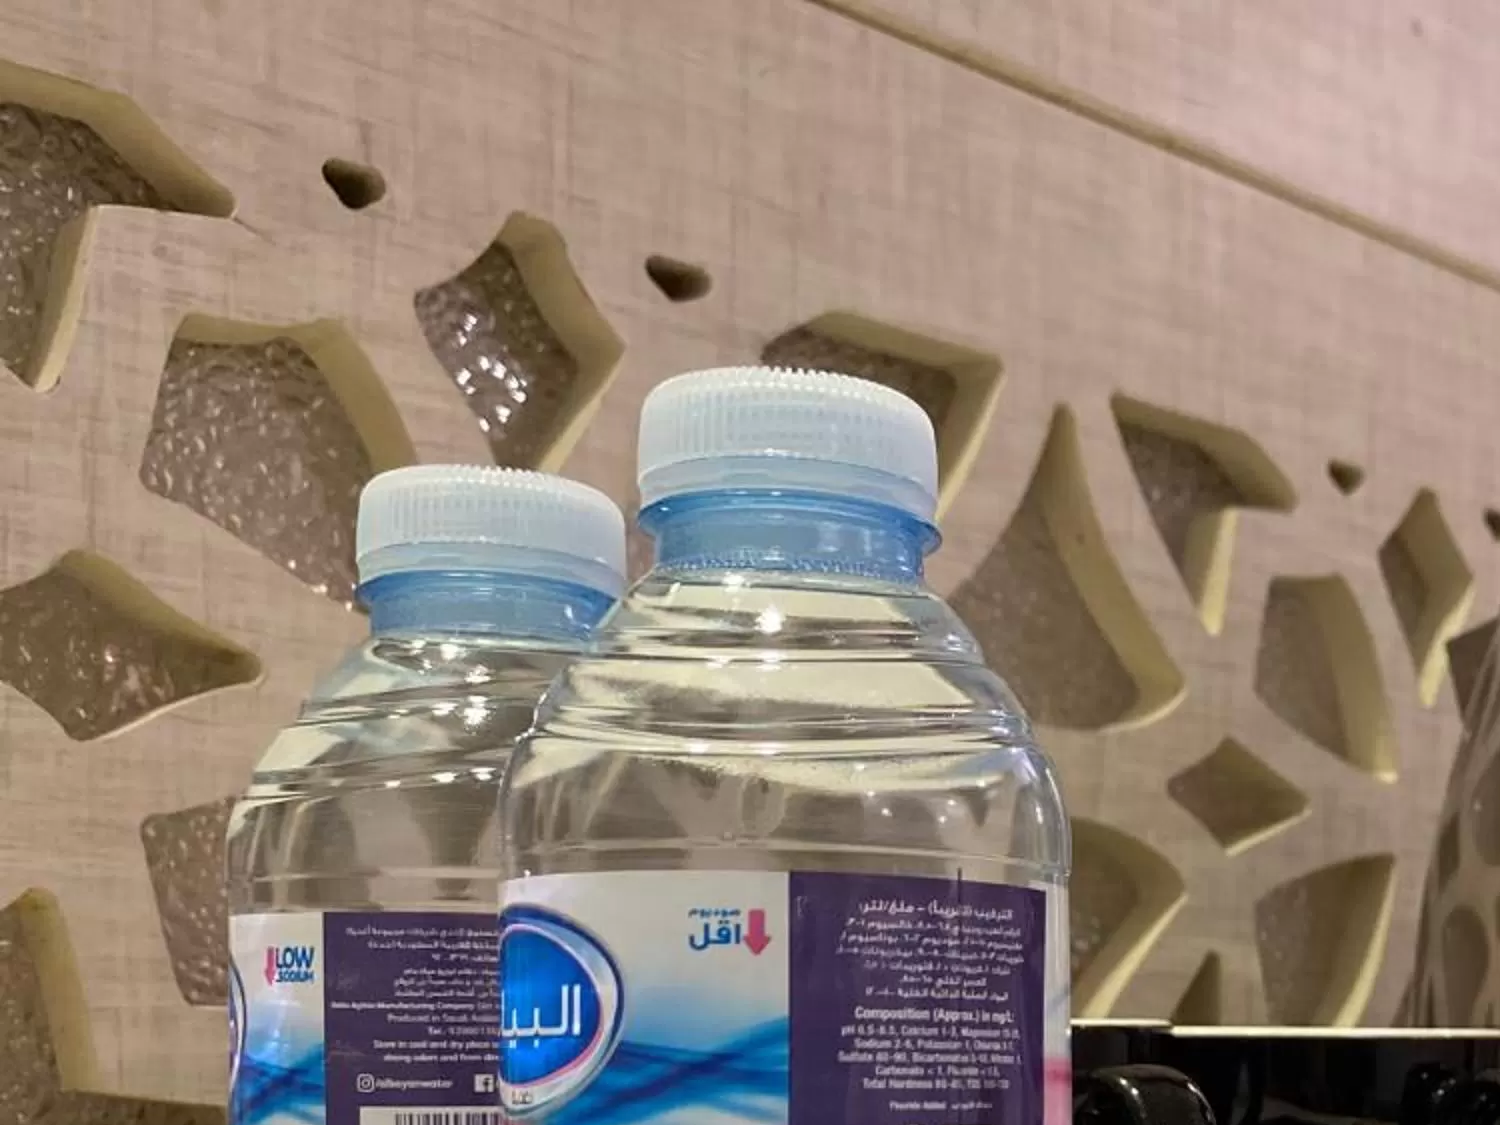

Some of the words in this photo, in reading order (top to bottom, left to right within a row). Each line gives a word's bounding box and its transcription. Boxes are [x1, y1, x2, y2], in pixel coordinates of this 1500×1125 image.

[276, 946, 315, 968] LOW
[500, 983, 582, 1049] البيا
[855, 1006, 930, 1022] Composition
